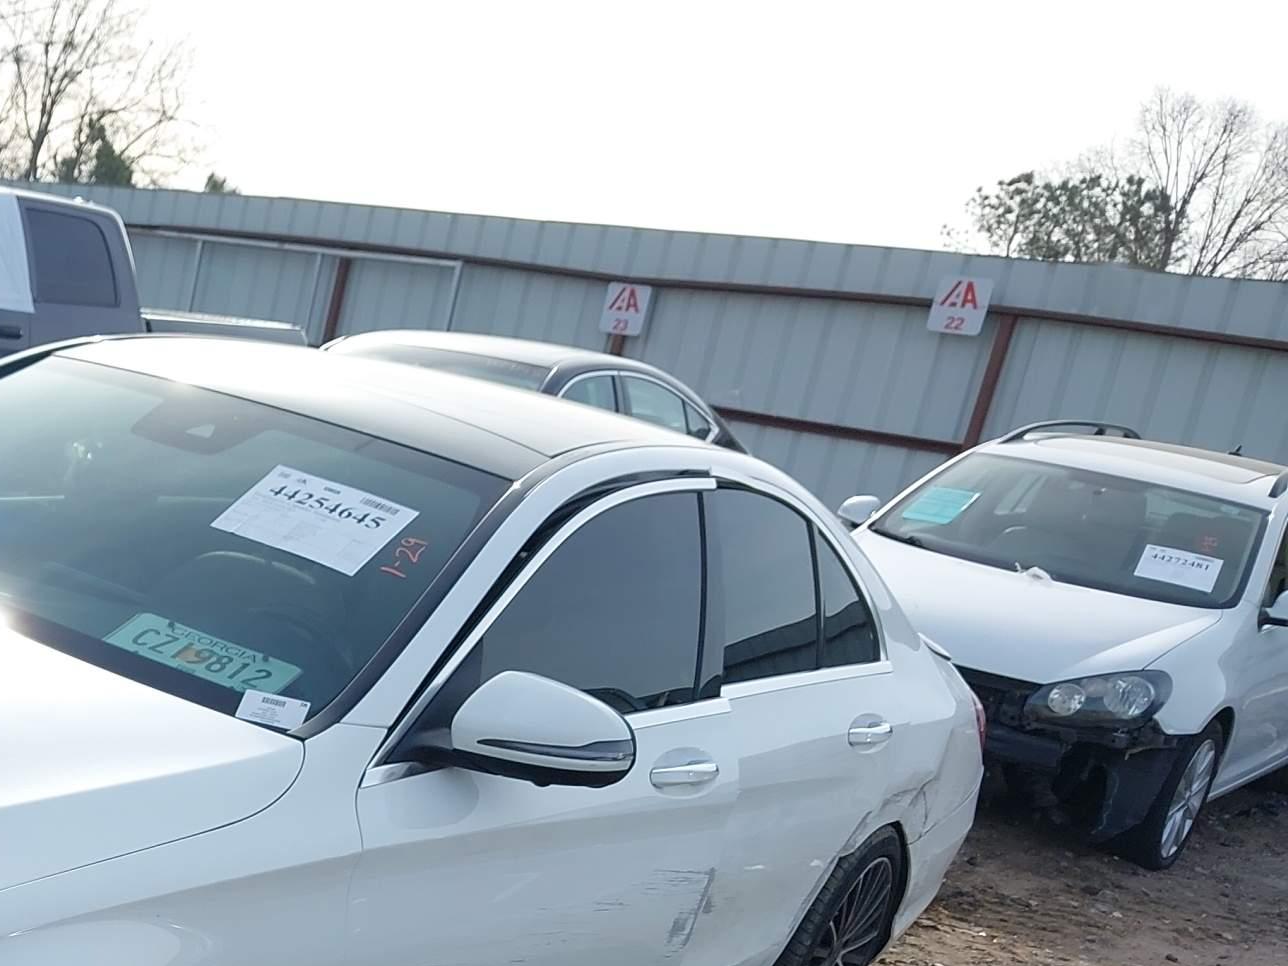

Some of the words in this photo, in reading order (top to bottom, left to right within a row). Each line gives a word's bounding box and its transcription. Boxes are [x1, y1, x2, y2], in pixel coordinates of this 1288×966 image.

[943, 316, 965, 331] 22
[268, 484, 387, 530] 44254645
[379, 536, 428, 579] 1-29
[172, 624, 257, 664] GEORGIA
